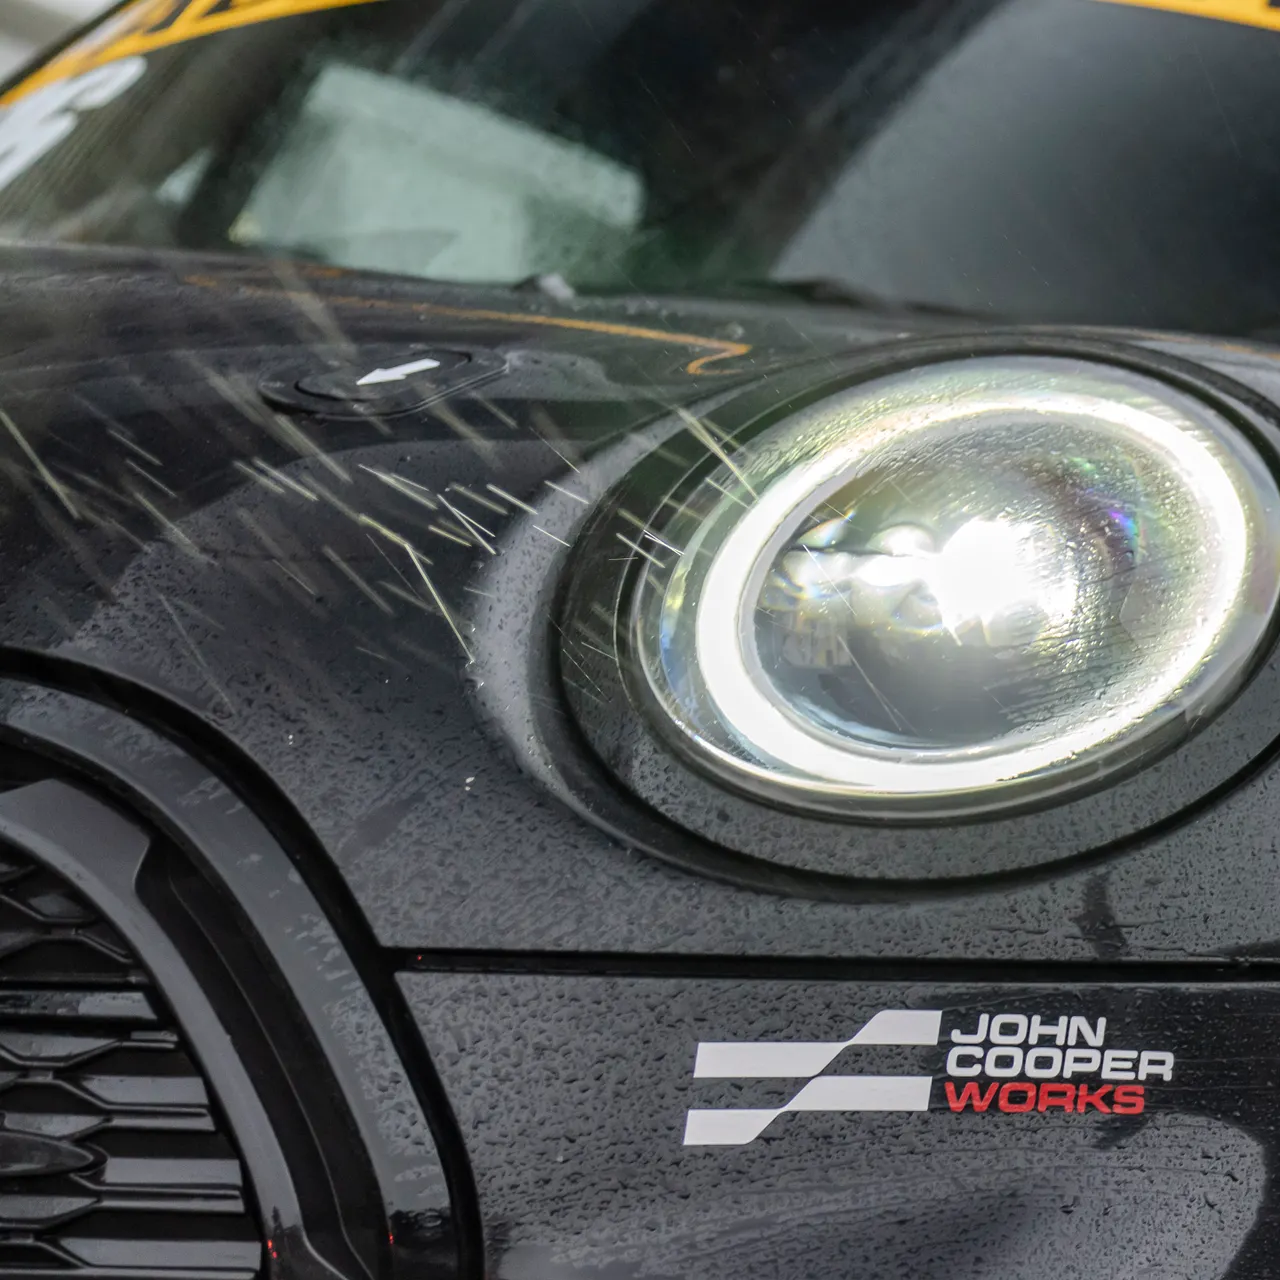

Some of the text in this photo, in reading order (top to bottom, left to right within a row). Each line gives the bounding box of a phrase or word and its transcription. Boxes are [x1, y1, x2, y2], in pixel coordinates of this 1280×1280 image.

[950, 1012, 1107, 1047] JOHN
[945, 1045, 1175, 1082] COOPER
[944, 1081, 1146, 1115] WORKS
